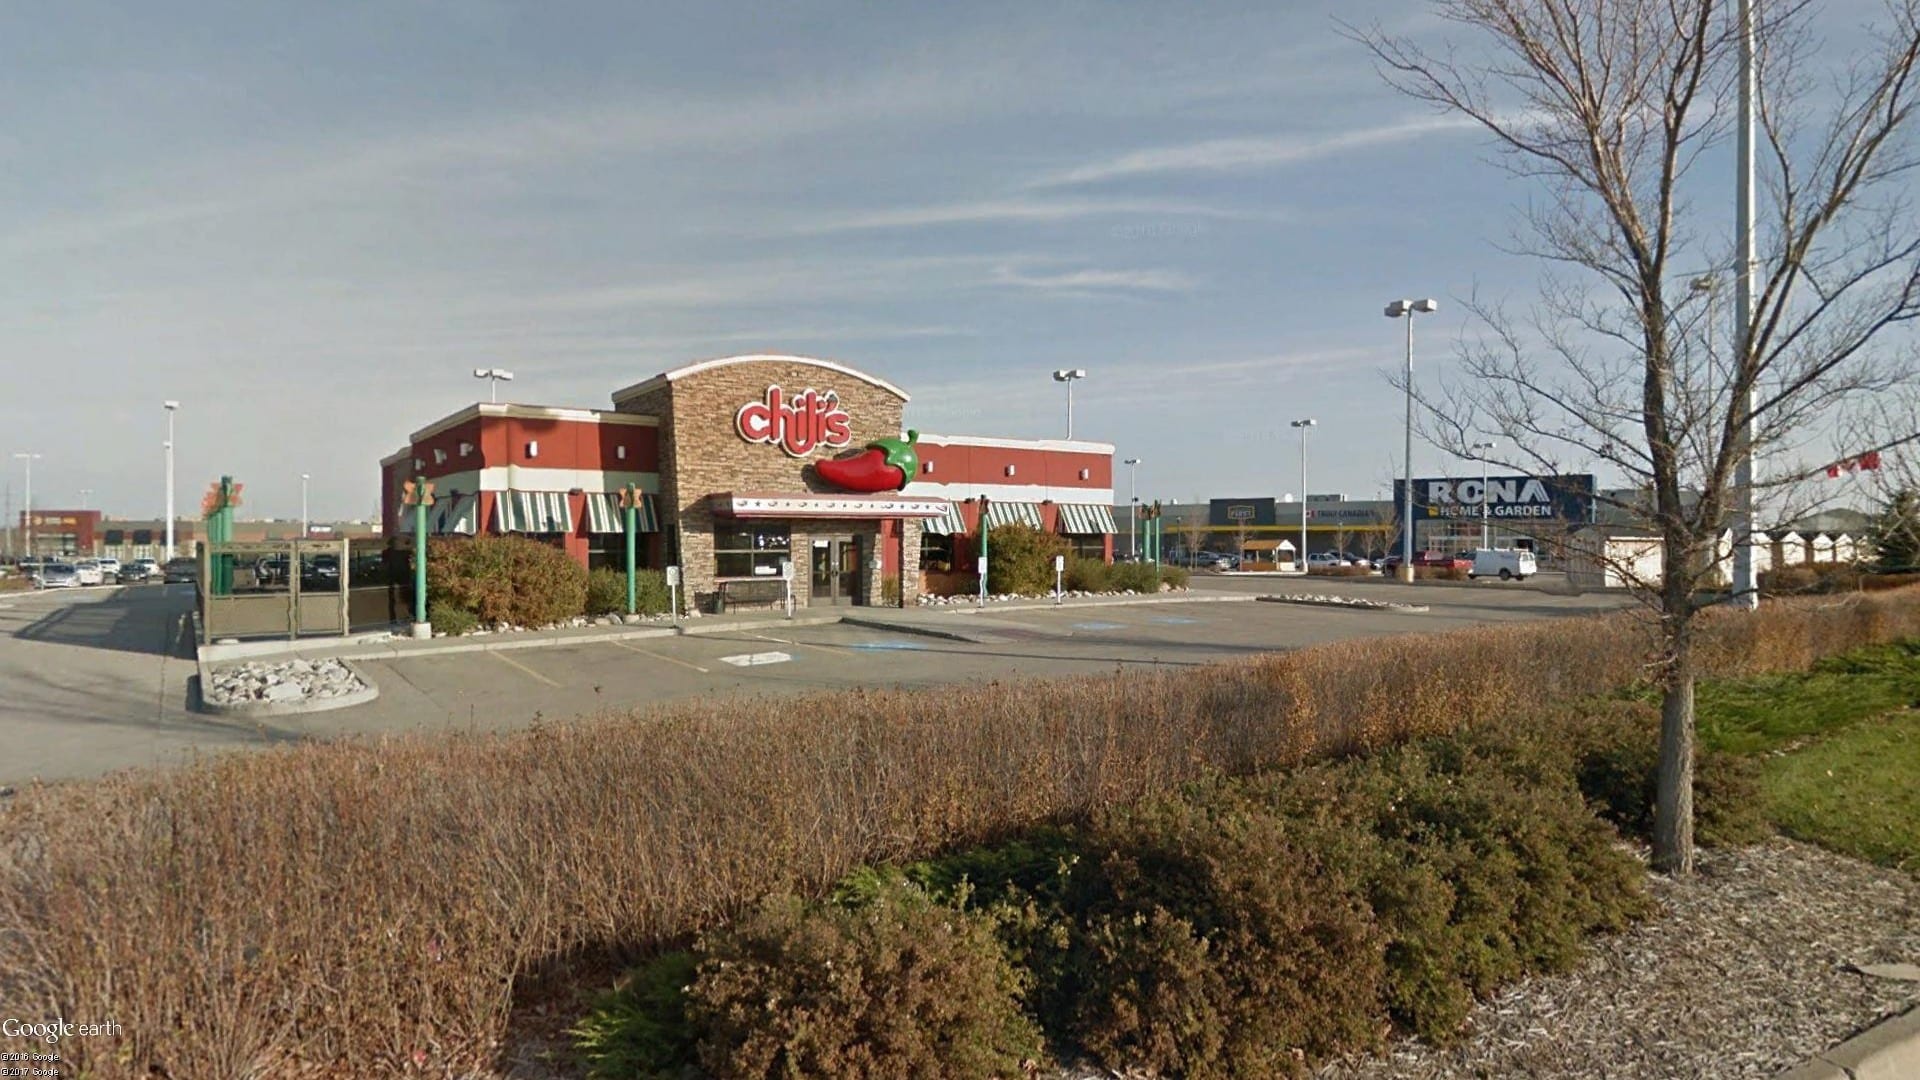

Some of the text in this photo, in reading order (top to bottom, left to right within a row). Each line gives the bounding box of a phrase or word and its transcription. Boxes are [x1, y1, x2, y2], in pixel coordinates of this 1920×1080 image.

[737, 384, 851, 457] chili's
[1428, 480, 1550, 503] RONA
[1440, 505, 1480, 517] HOME
[1494, 505, 1552, 516] GARDEN
